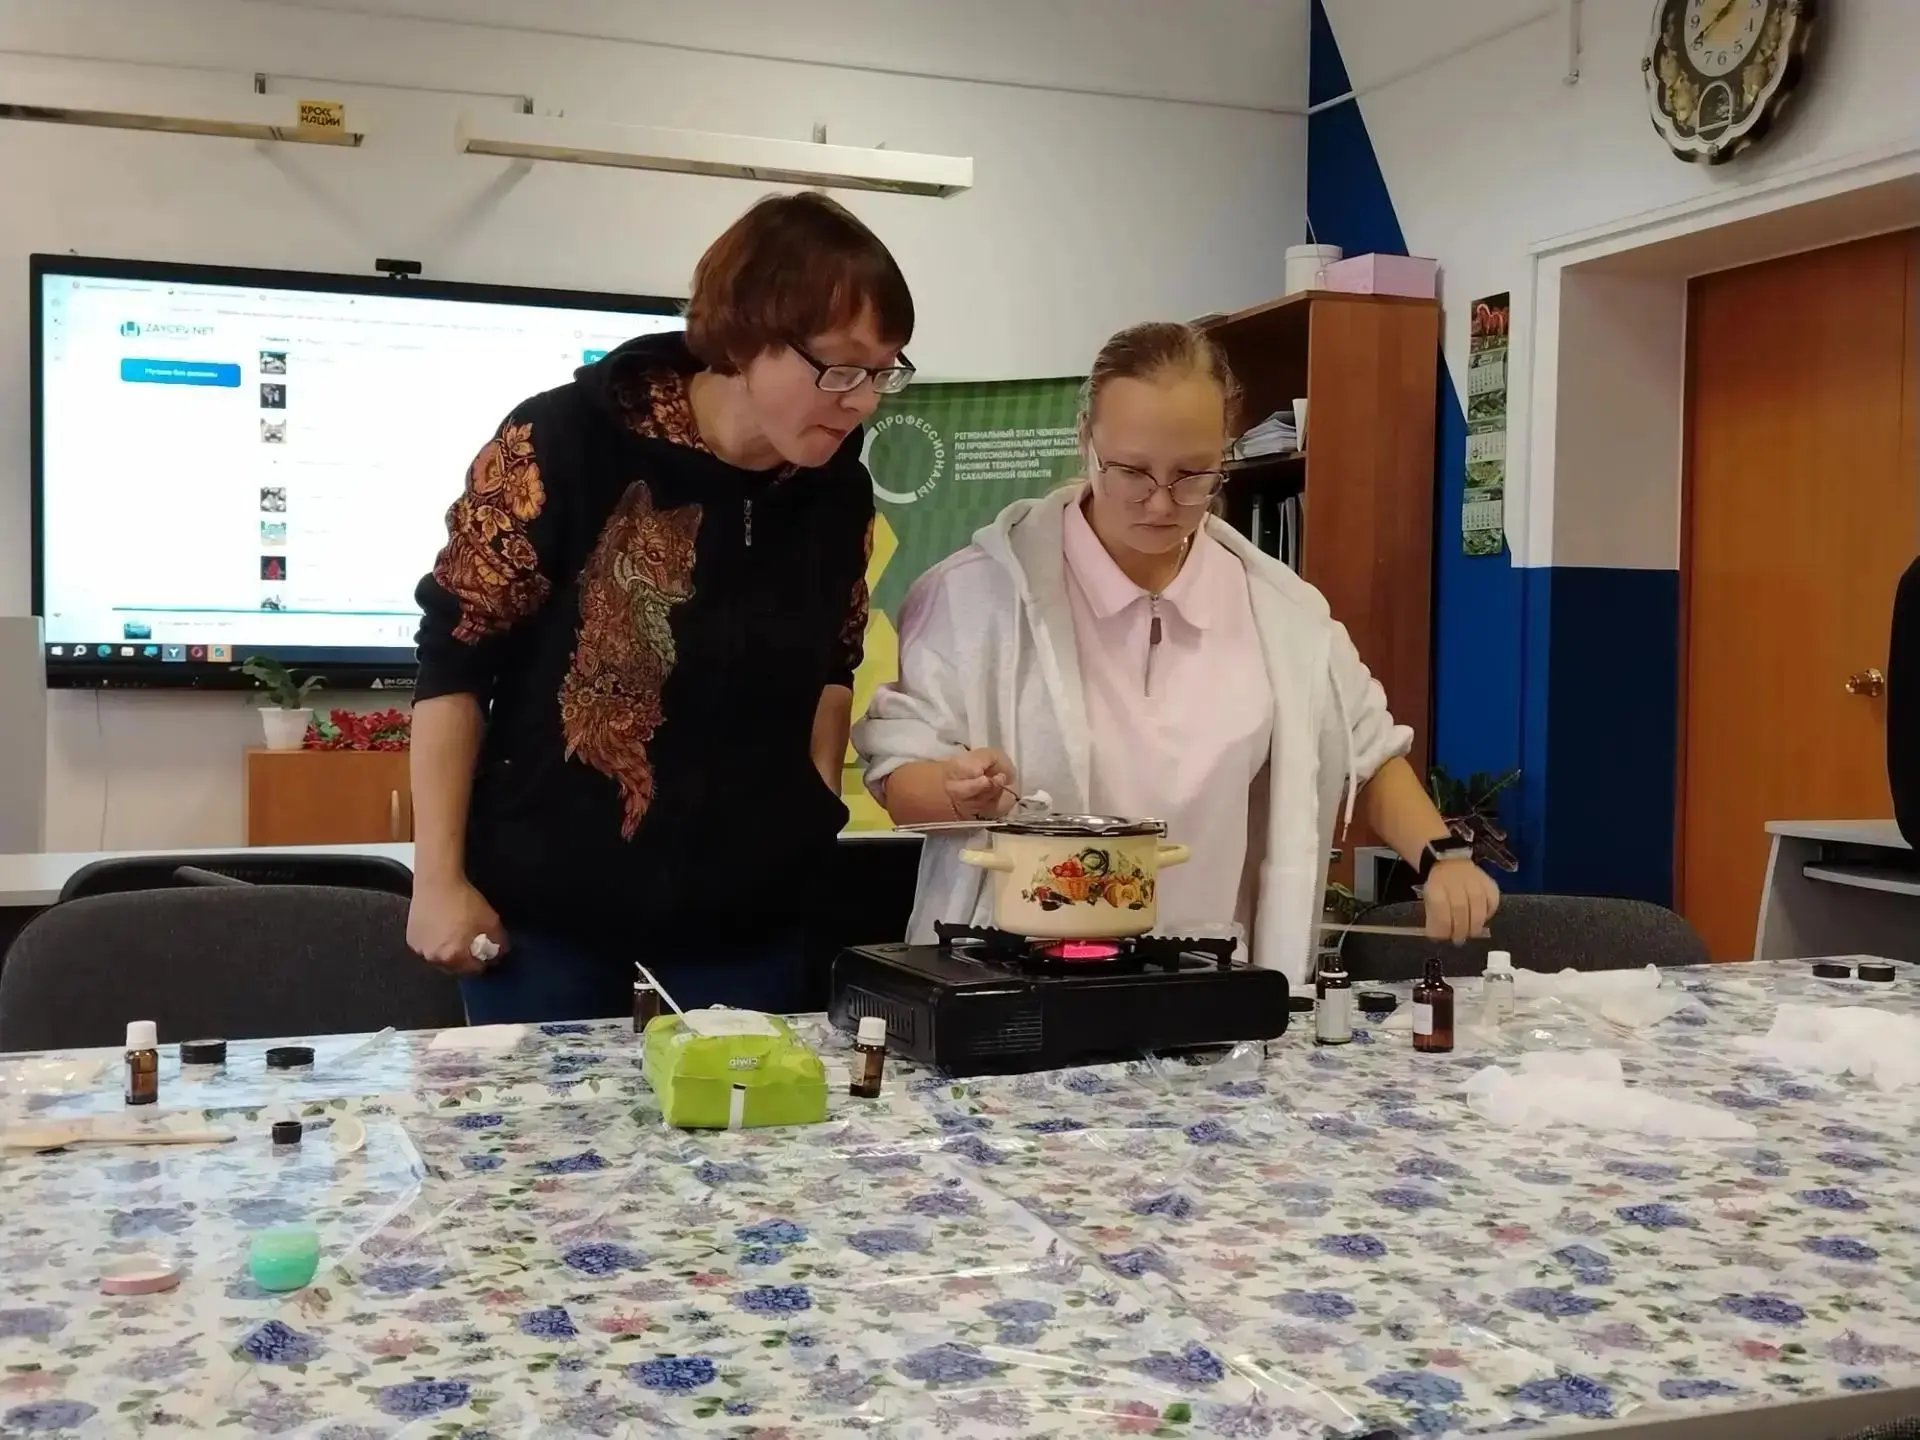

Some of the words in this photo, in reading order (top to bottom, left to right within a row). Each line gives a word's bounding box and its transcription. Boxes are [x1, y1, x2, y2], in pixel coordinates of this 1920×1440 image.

[1690, 15, 1700, 29] 9
[1734, 39, 1743, 54] 5
[1704, 51, 1713, 65] 7
[1717, 51, 1727, 66] 6
[301, 105, 332, 117] КРОСС
[301, 115, 340, 126] НАЦИИ
[954, 428, 1014, 440] РЕГИОНАЛЬНЫЙ
[1016, 429, 1035, 437] ЭТАП
[954, 442, 965, 450] ПО
[966, 438, 1052, 450] ПРОФЕССИОНАЛЬНОМУ
[876, 414, 945, 498] ПРОФЕССИОНАЛЫ
[1030, 448, 1036, 457] И
[954, 462, 990, 471] ВЫСОКИХ
[991, 458, 1040, 469] ТЕХНОЛОГИЙ
[954, 472, 961, 480] В
[961, 469, 1015, 480] САХАЛИНСКОЙ
[1017, 468, 1051, 478] ОБЛАСТИ
